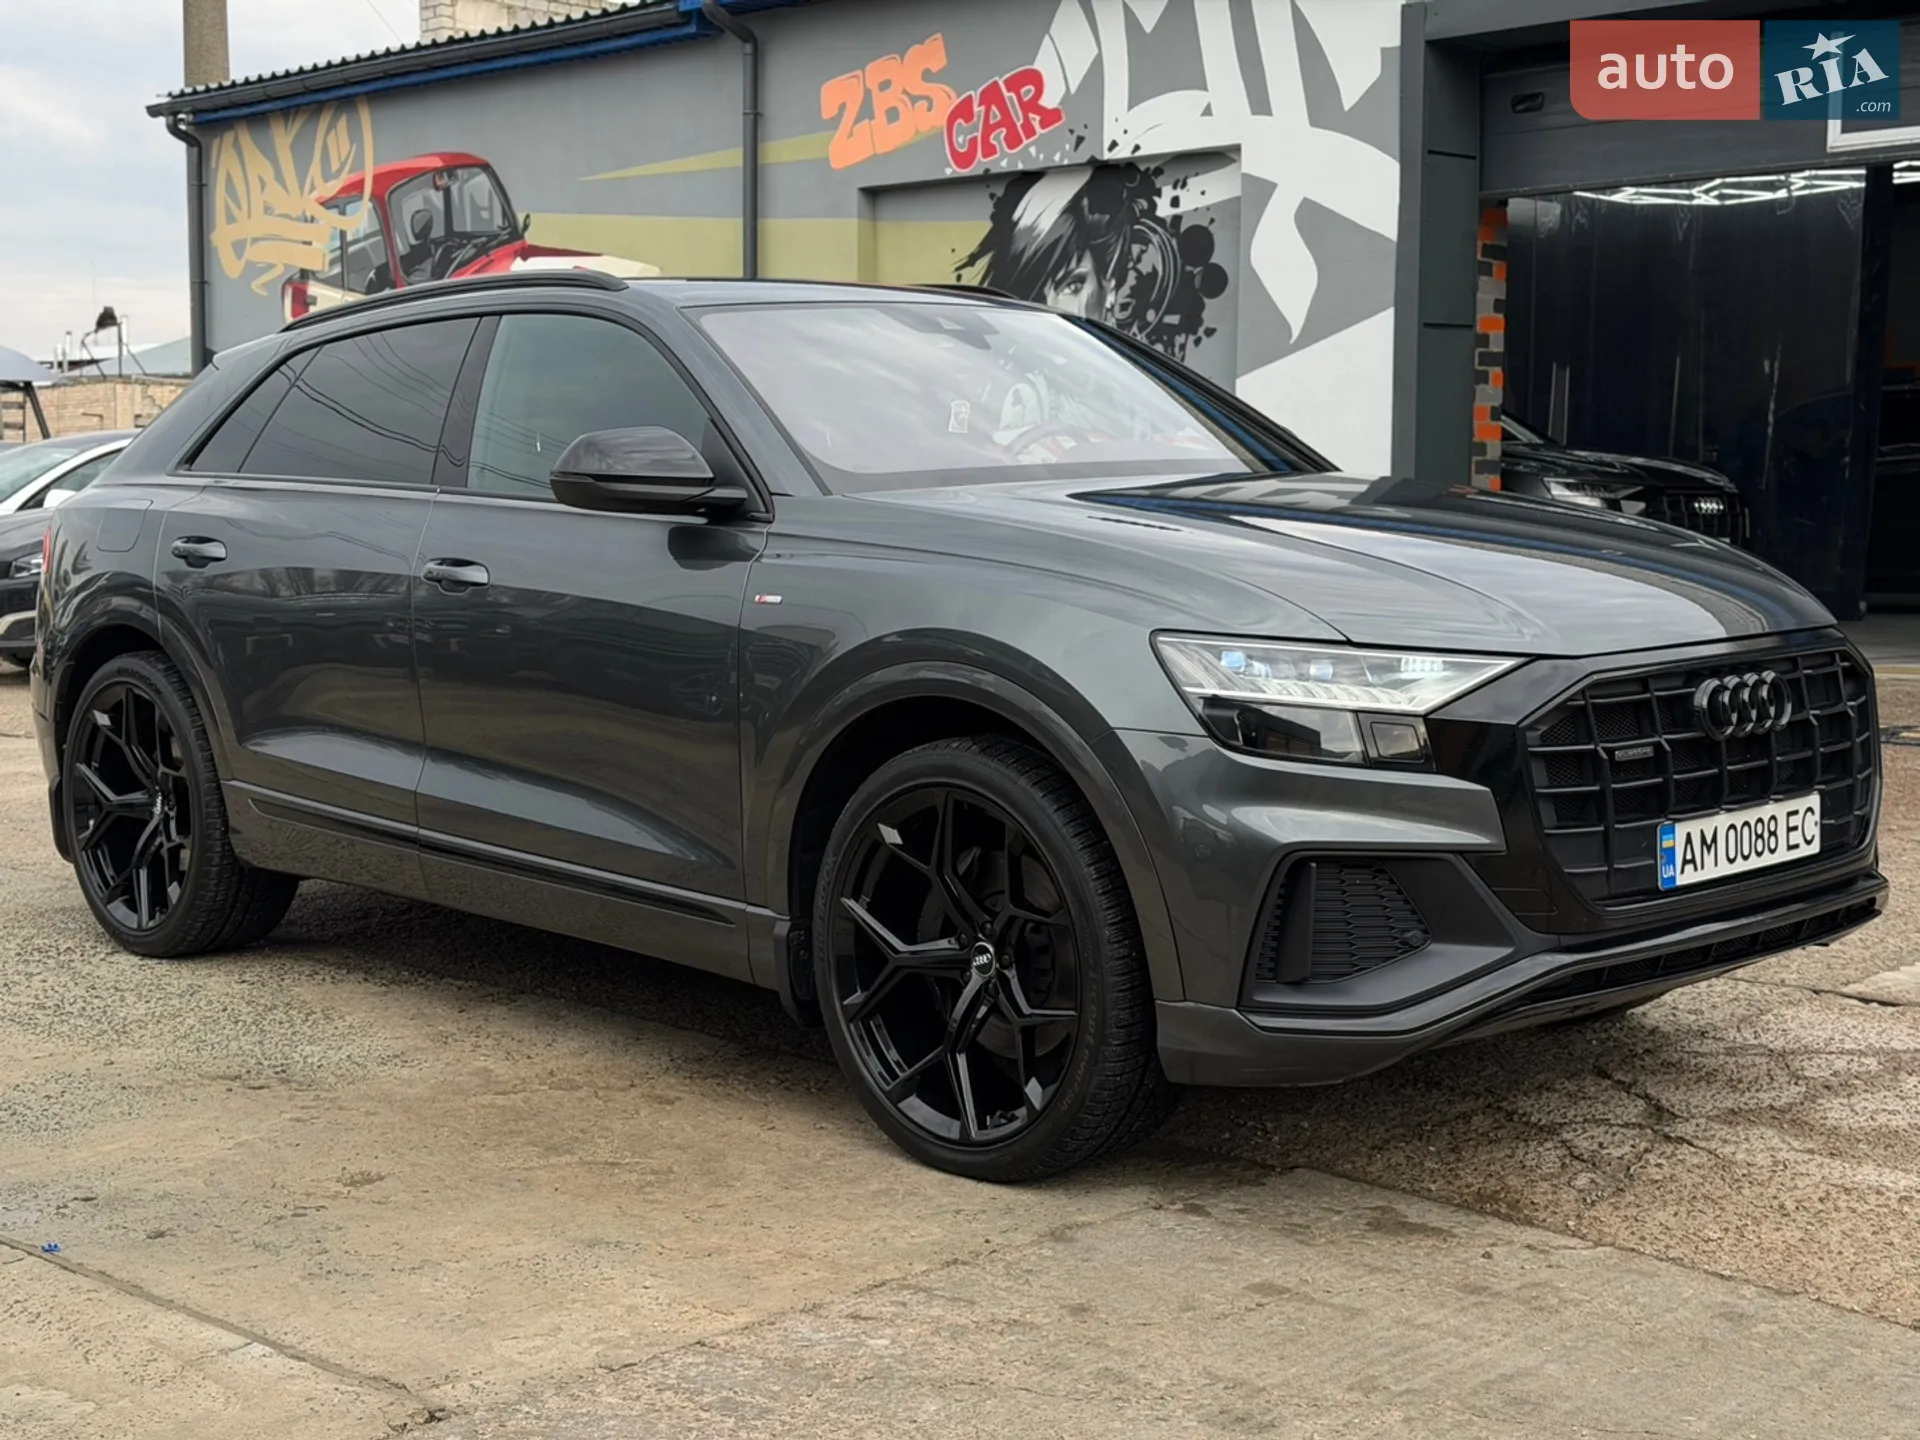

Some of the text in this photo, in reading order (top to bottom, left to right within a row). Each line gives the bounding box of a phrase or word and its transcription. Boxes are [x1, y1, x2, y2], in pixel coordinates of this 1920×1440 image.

[821, 33, 1065, 172] ZBS CAR
[1662, 864, 1675, 878] UA
[1679, 806, 1815, 875] AM 0088 EC
